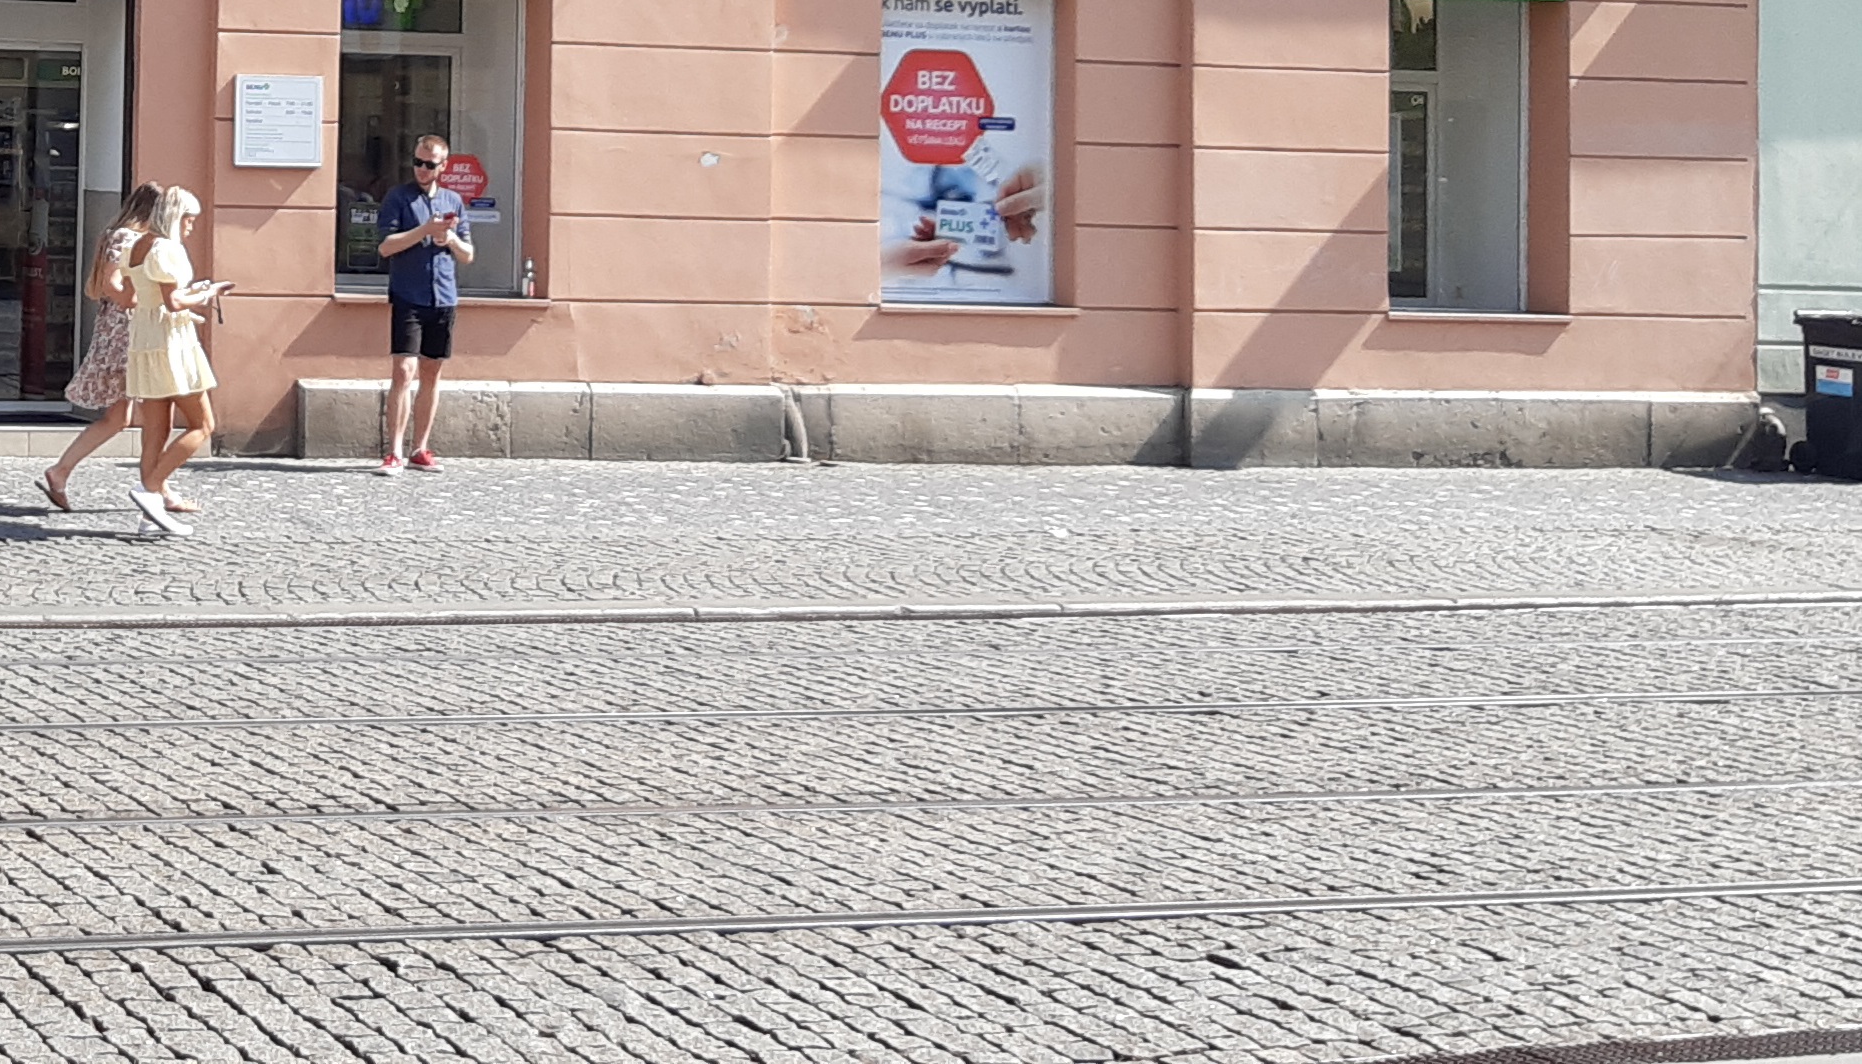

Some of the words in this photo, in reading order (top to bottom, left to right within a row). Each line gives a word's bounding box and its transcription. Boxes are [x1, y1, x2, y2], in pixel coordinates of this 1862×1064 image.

[917, 70, 956, 91] BEZ
[889, 95, 986, 115] DOPLATKU
[905, 118, 924, 130] NA
[926, 119, 969, 132] RECEPT
[452, 163, 472, 173] BEZ
[440, 173, 484, 184] DOPLATKU
[940, 218, 975, 234] PLUS
